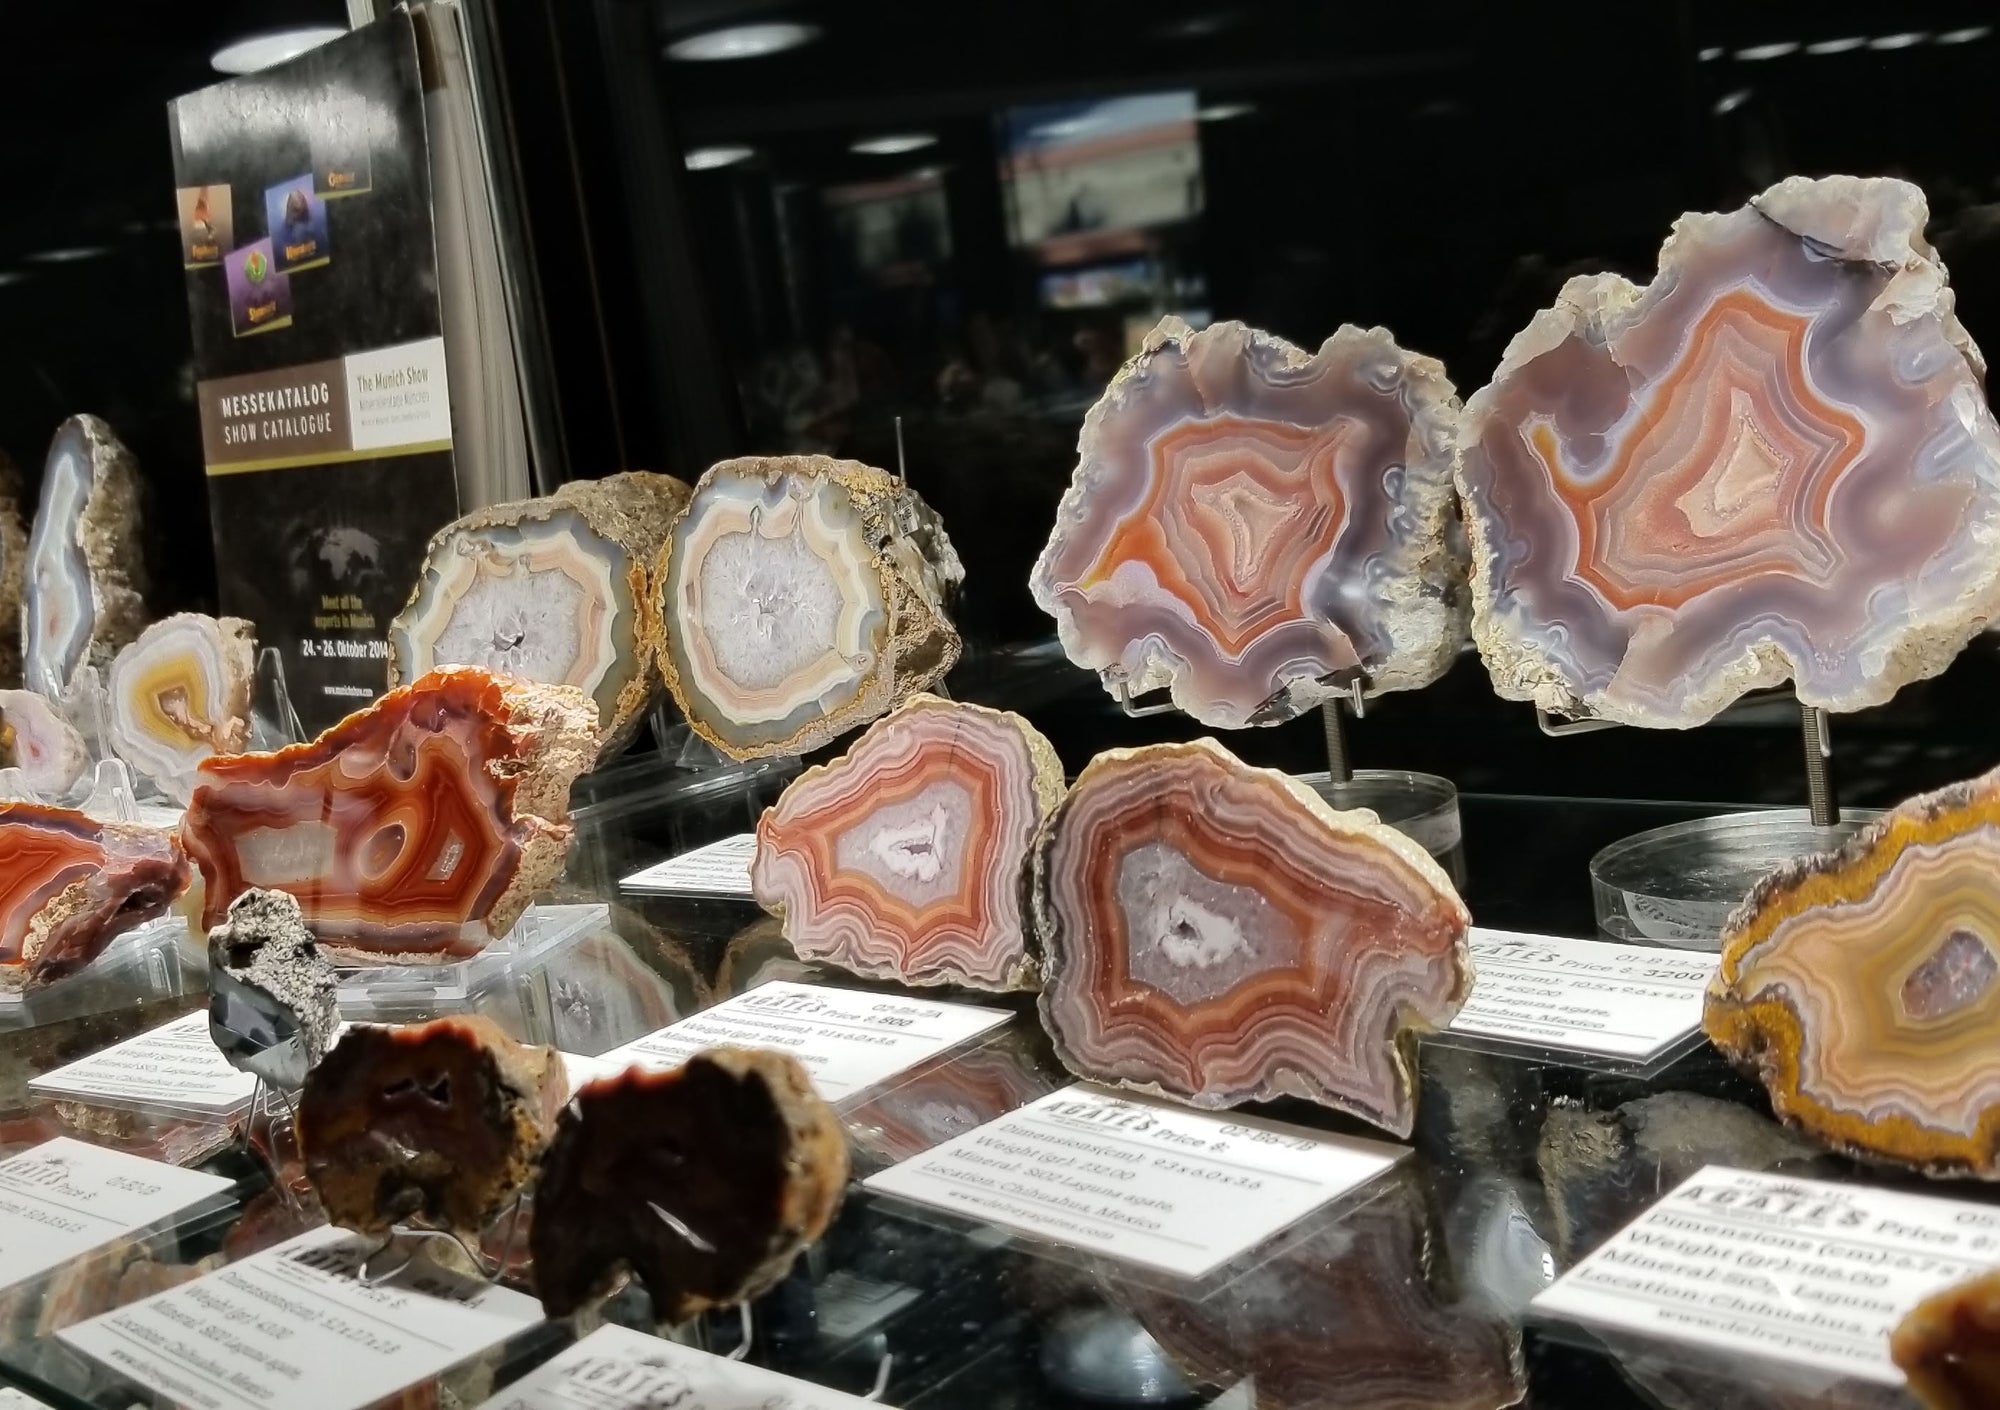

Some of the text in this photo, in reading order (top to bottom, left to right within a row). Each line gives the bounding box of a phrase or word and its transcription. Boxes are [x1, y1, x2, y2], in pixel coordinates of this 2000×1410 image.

[357, 366, 429, 392] The Munich Show
[222, 382, 329, 418] MESSEKATALOG
[225, 424, 256, 445] SHOW
[263, 412, 332, 440] CATALOGUE
[336, 640, 367, 658] Oktober
[1559, 959, 1613, 972] Price
[1643, 969, 1704, 981] 3200
[738, 995, 827, 1013] AGATES
[821, 1009, 861, 1020] Price
[878, 1016, 914, 1027] 800
[1492, 996, 1556, 1010] Laguna
[1537, 1014, 1605, 1029] Mexico
[1042, 1101, 1158, 1132] AGATES
[1151, 1129, 1206, 1147] Price
[976, 1136, 1040, 1158] Weight
[1059, 1177, 1123, 1199] Laguna
[1094, 1207, 1161, 1230] Mexico
[1678, 1185, 1868, 1226] AGATES
[1874, 1220, 1959, 1244] Price
[1630, 1230, 1732, 1259] Weight
[1647, 1214, 1813, 1252] Dimensions
